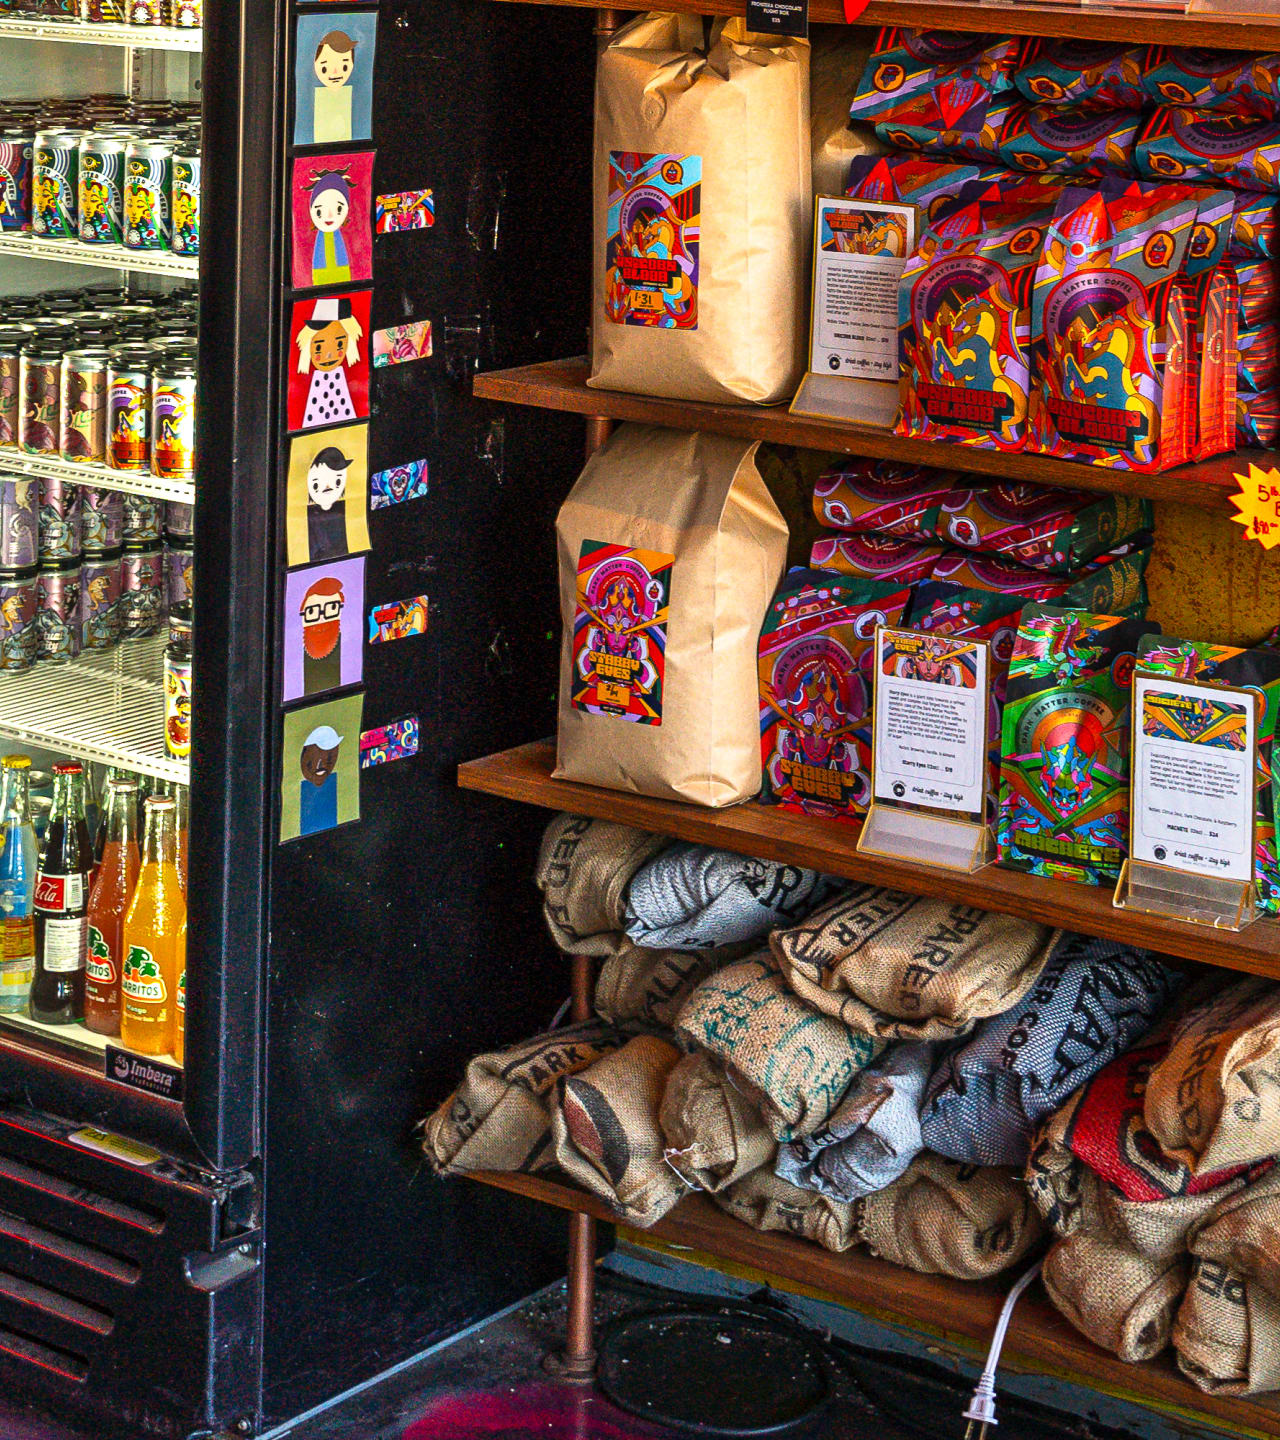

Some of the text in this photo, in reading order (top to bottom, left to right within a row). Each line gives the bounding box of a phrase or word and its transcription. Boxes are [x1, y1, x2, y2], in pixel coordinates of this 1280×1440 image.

[623, 268, 668, 283] BLOOD
[1057, 416, 1127, 442] BLOOD
[589, 650, 640, 671] STARRY
[596, 664, 631, 681] EYES
[780, 758, 856, 788] STARRY
[791, 775, 843, 801] EYES
[1014, 830, 1122, 864] MACHETE
[126, 1004, 147, 1015] Mango
[130, 1061, 173, 1085] Imbera
